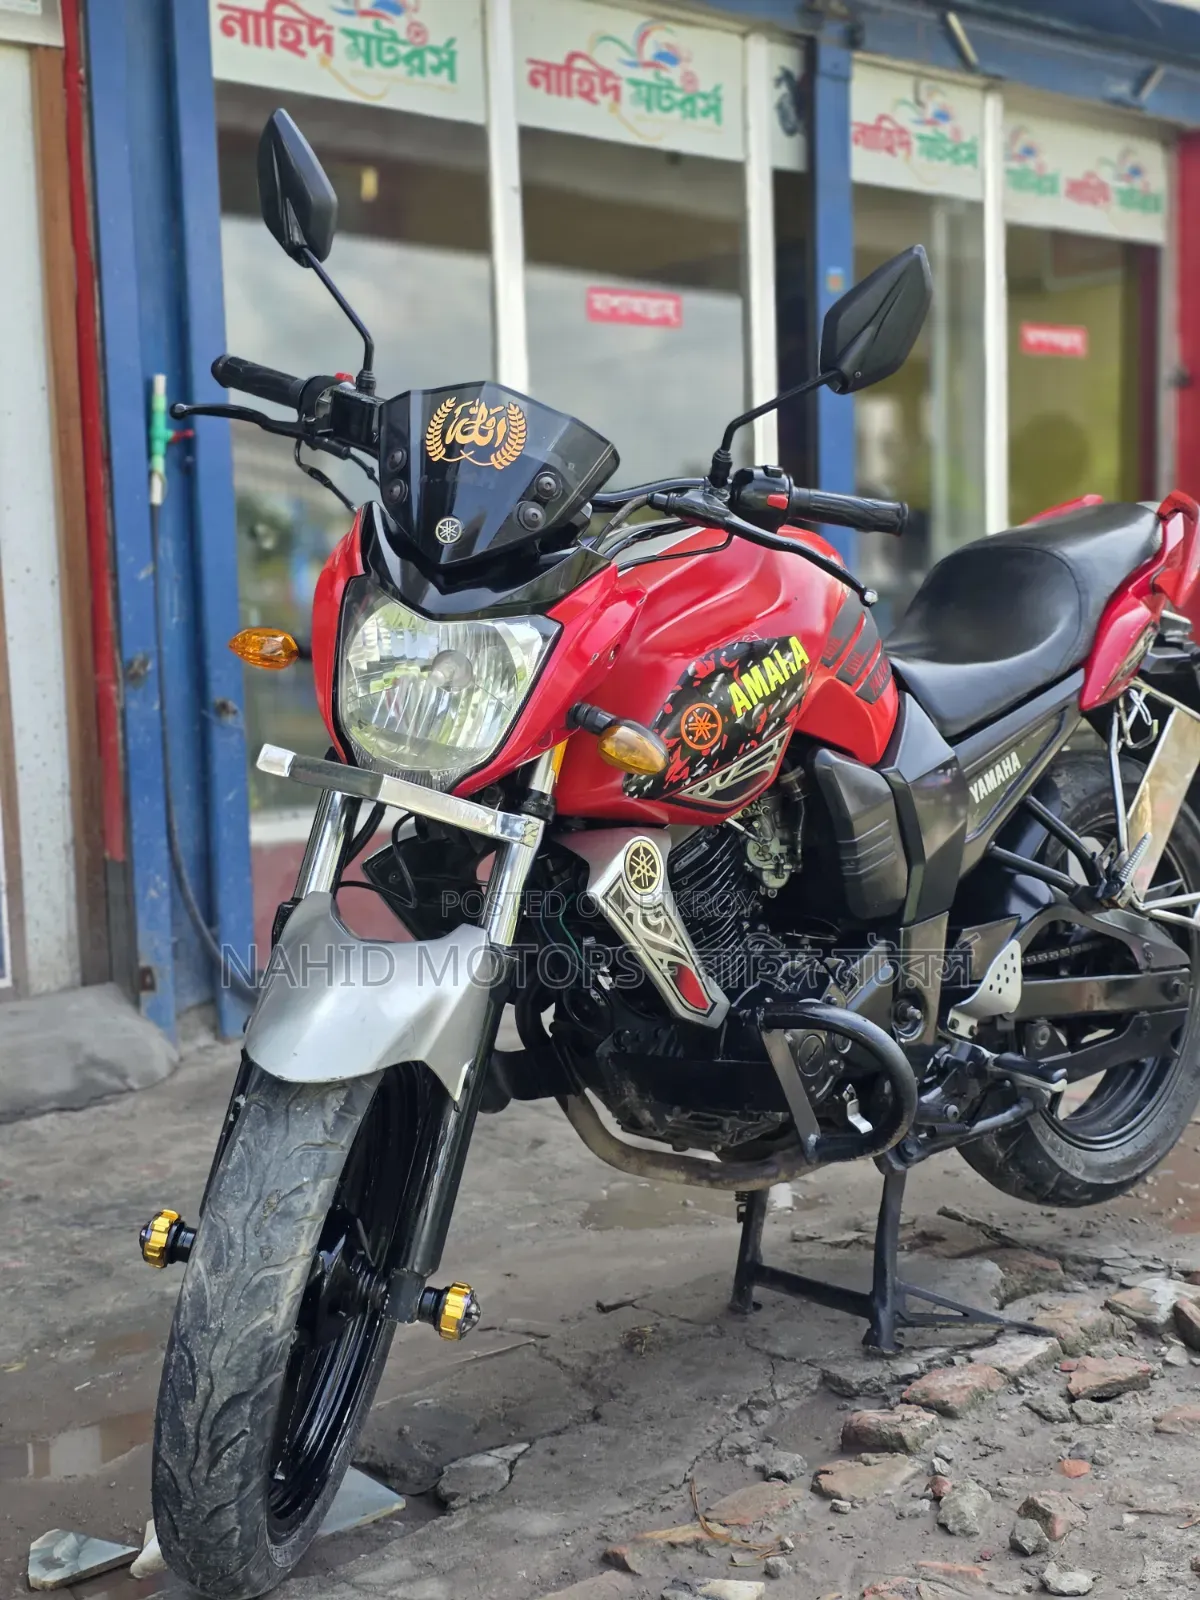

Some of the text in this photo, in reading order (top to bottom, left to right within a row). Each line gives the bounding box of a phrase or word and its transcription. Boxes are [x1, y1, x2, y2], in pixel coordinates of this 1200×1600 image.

[217, 0, 334, 59] নাহিদ
[526, 50, 622, 106] নাহিদ
[968, 751, 1022, 804] YAMAHA
